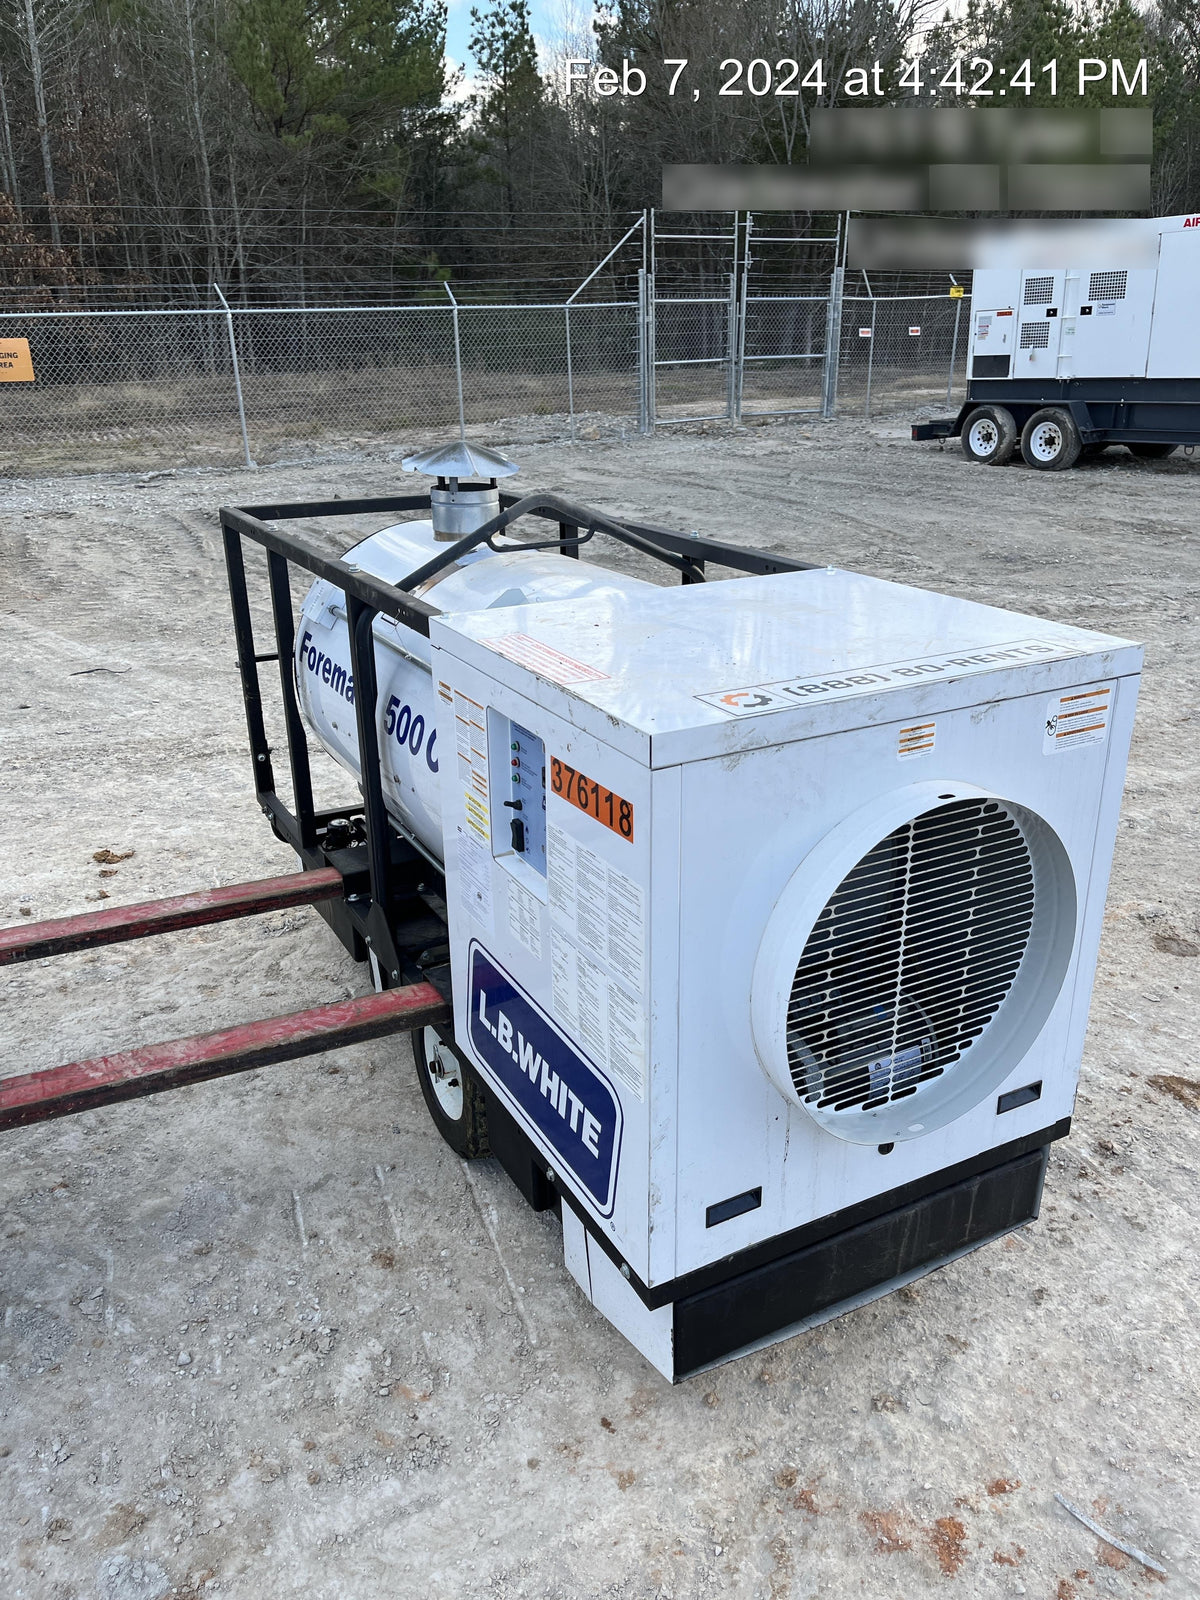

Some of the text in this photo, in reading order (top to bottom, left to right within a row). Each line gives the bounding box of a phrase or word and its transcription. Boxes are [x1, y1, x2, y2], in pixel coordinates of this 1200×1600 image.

[782, 645, 1054, 697] (888) 80-RENTS
[384, 695, 425, 756] 500
[552, 758, 632, 838] 376118
[479, 988, 602, 1160] L.B.WHITE
